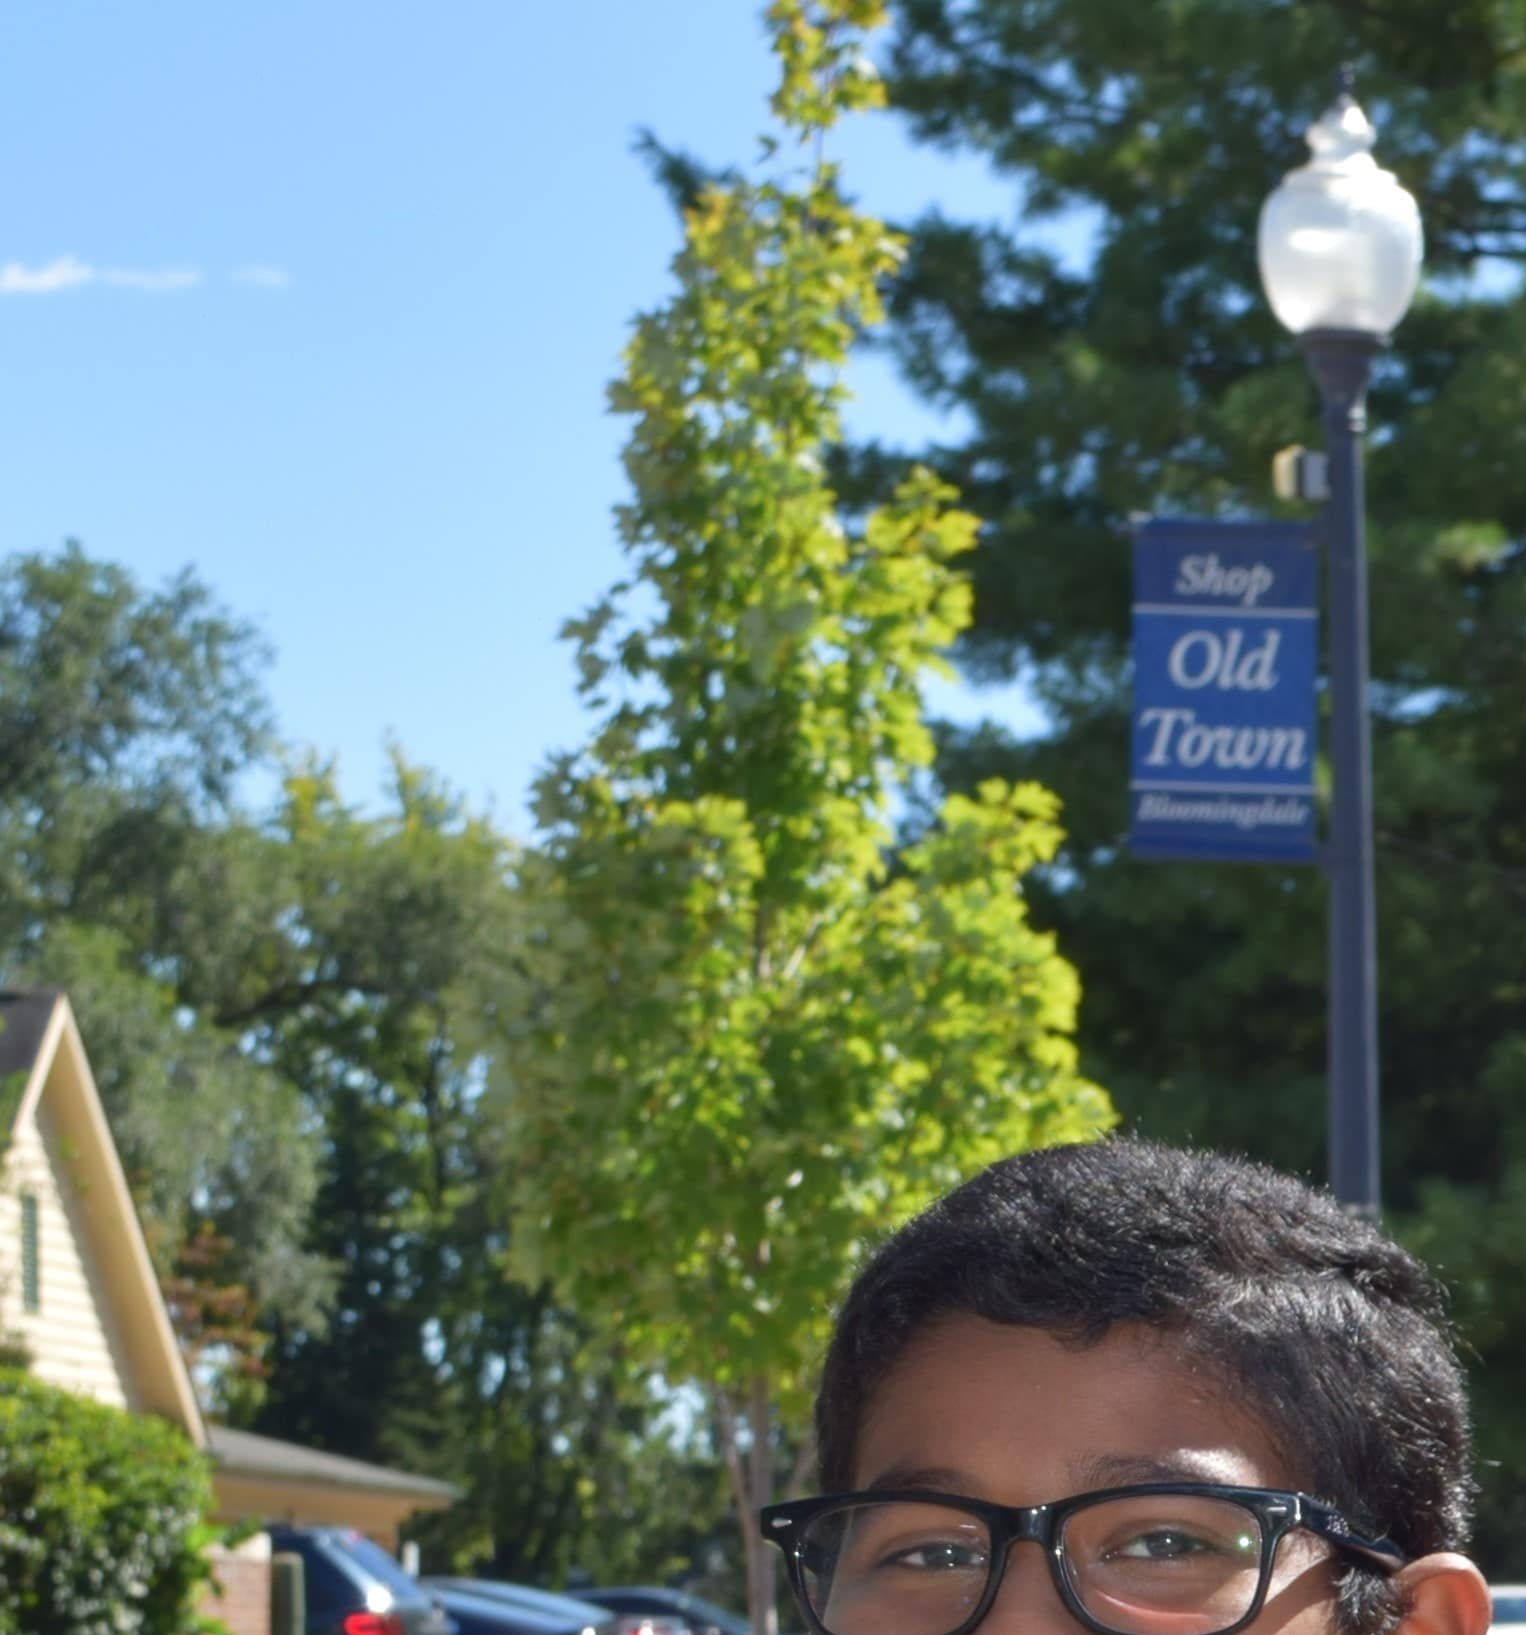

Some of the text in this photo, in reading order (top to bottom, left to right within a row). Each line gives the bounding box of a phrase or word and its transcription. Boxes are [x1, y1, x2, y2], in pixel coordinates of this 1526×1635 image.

[1173, 552, 1274, 608] Shop
[1168, 628, 1282, 692] Old
[1139, 707, 1308, 771] Town
